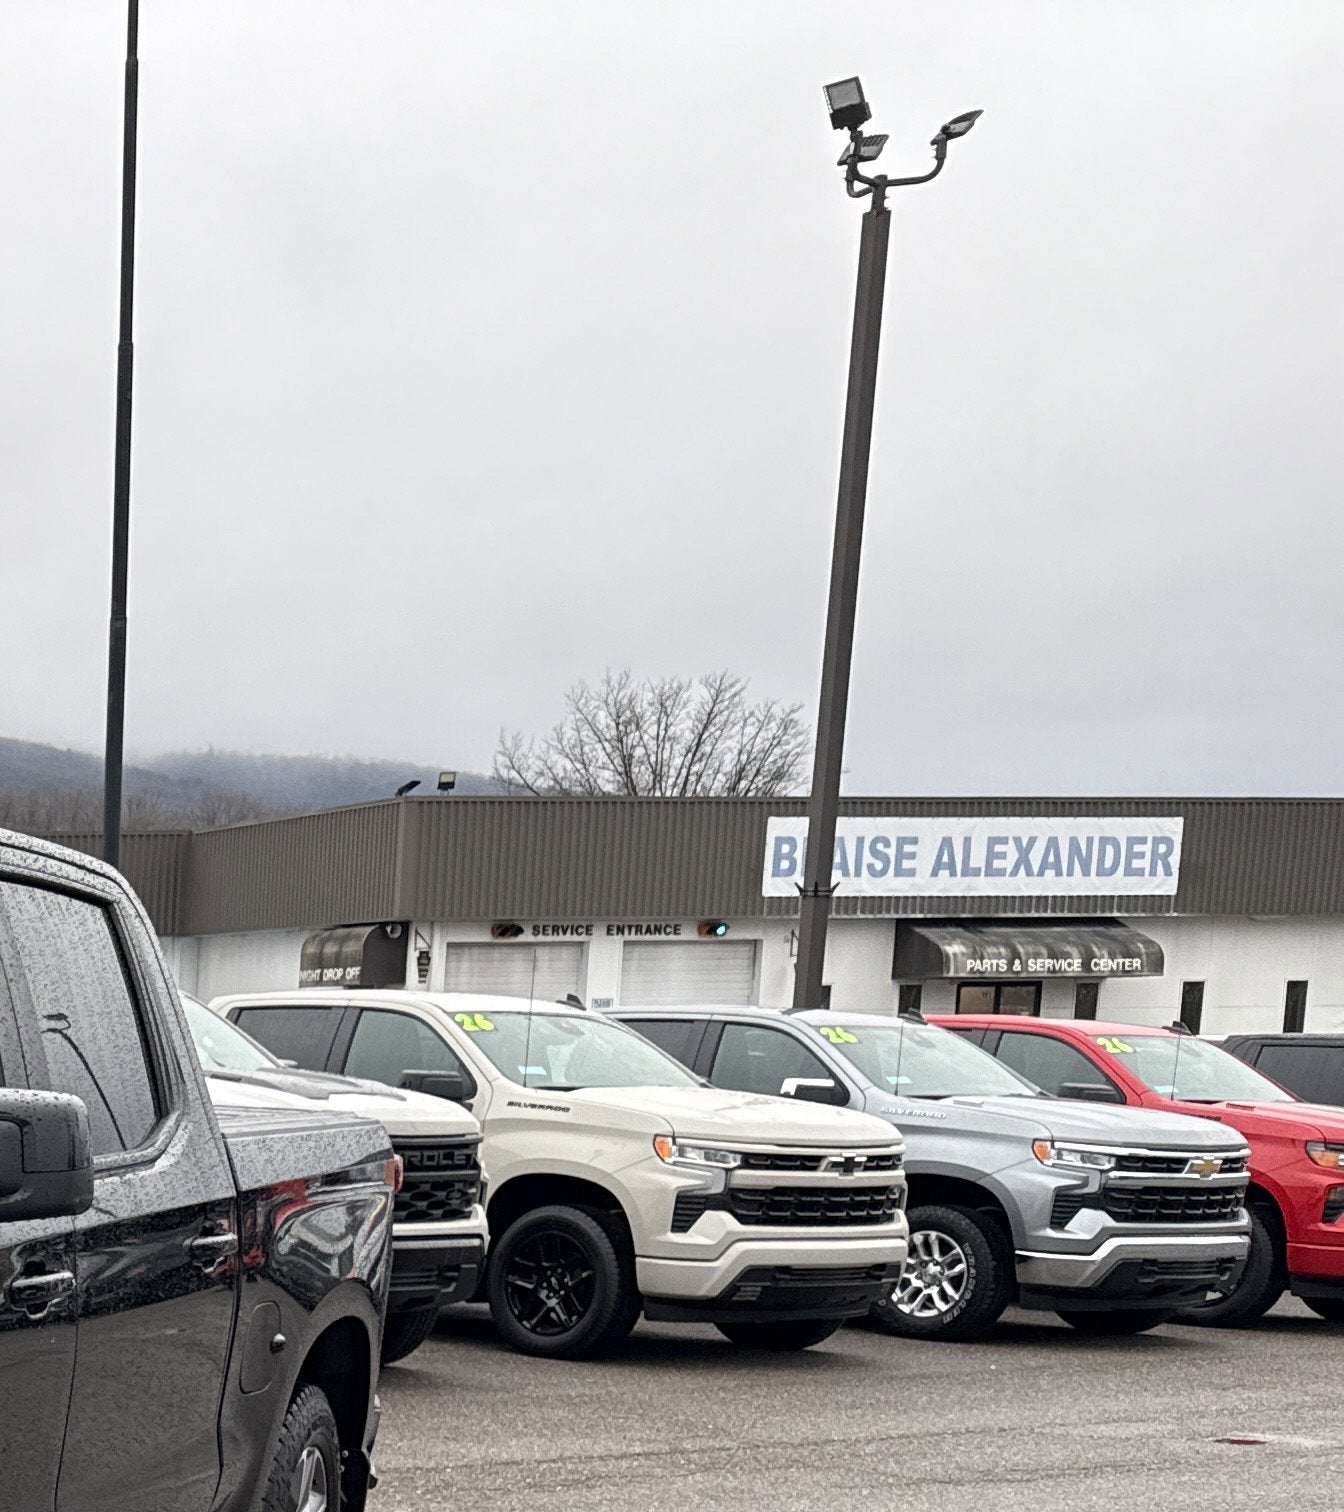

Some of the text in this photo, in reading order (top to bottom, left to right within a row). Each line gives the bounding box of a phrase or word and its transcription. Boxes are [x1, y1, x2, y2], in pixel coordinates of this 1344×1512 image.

[930, 836, 1175, 877] ALEXANDER
[531, 924, 682, 937] SERVICE ENTRANCE
[966, 957, 1142, 972] PARTS & SERVICE CENTER
[322, 967, 344, 982] DROP
[345, 966, 362, 981] OFF
[454, 1013, 495, 1032] 26
[819, 1026, 859, 1044] 26
[1096, 1037, 1135, 1054] 26
[402, 1150, 476, 1167] ROLET
